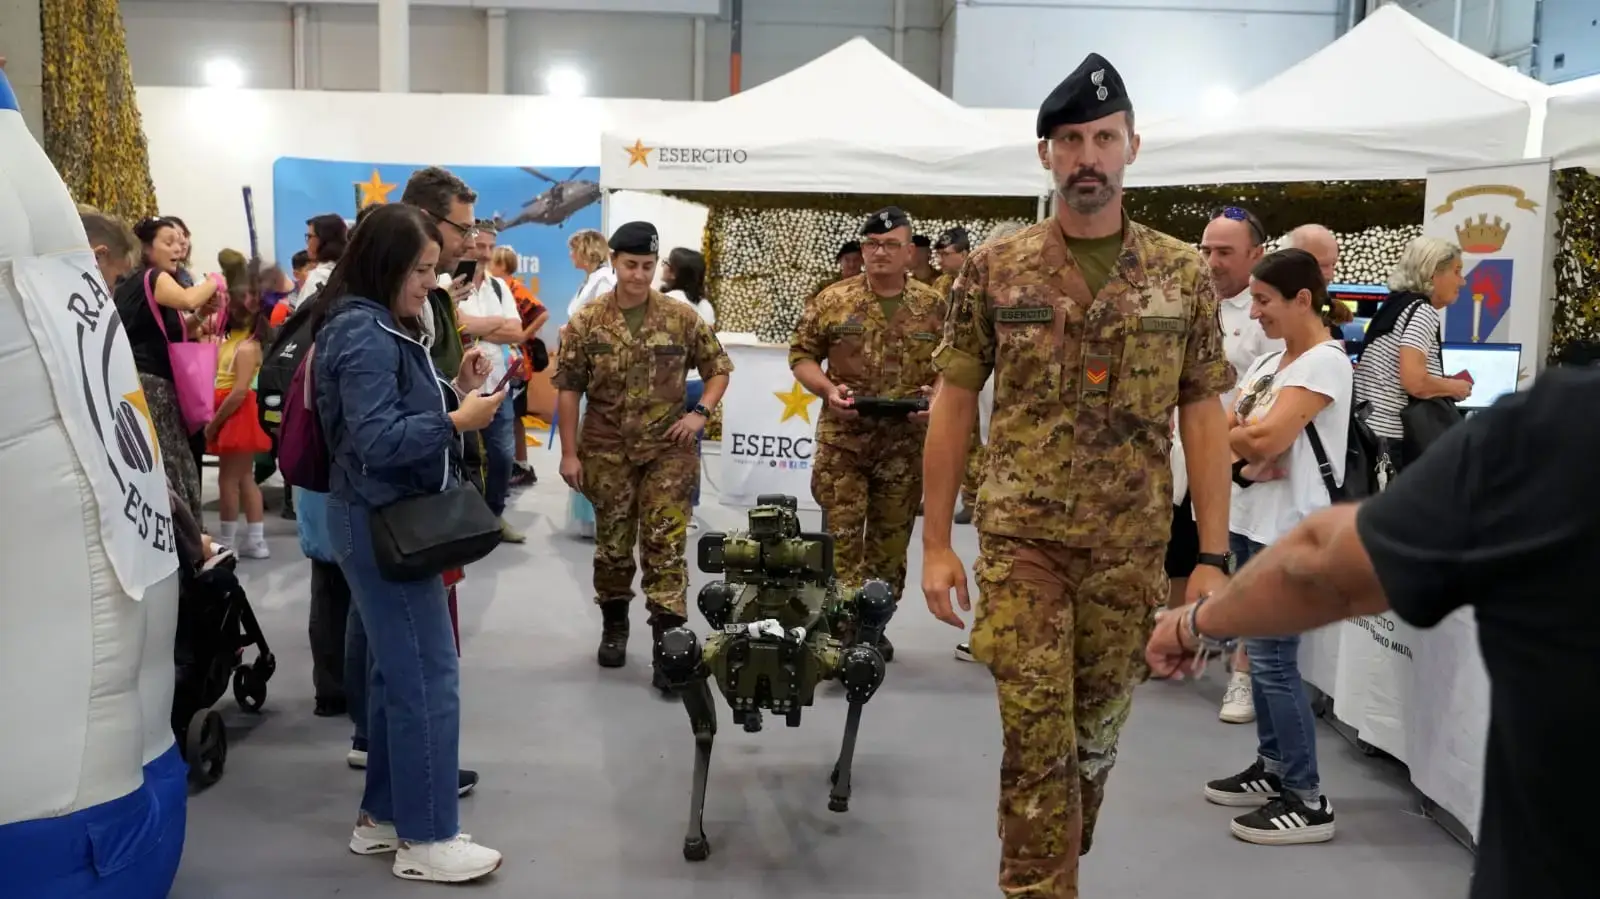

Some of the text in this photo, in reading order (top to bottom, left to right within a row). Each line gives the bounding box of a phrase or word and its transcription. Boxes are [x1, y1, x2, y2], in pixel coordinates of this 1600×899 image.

[659, 147, 748, 164] ESERCITO
[1001, 310, 1049, 320] ESERCITO
[731, 433, 813, 460] ESERC
